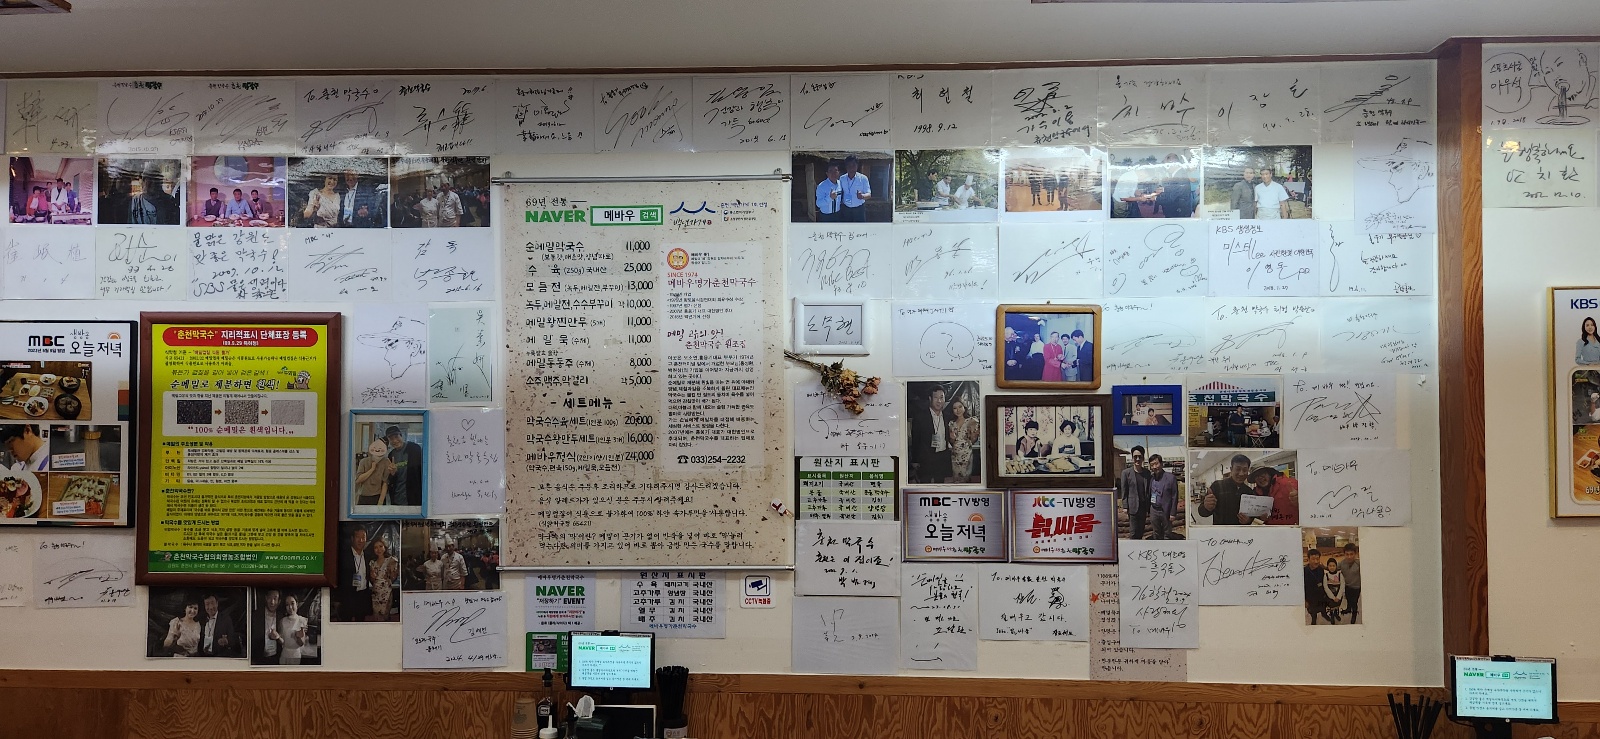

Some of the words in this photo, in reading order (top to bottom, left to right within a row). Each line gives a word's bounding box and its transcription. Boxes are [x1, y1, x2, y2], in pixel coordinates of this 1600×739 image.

[525, 210, 586, 223] NAVER
[604, 209, 635, 222] 메바우
[642, 210, 657, 219] 검색
[1216, 225, 1234, 234] KBS
[526, 241, 585, 253] 순메밀막국수
[626, 240, 650, 251] 11,000
[624, 263, 652, 273] 25,000
[627, 281, 653, 291] 13,000
[1570, 298, 1598, 309] KBS
[526, 317, 587, 328] 메밀왕찐만두
[627, 316, 651, 327] 11,000
[221, 330, 258, 339] 지리적표시
[260, 330, 290, 339] 단체표장
[292, 330, 307, 339] 등록
[628, 335, 651, 345] 11,000
[526, 357, 573, 368] 메밀동동주
[629, 357, 652, 368] 8,000
[170, 379, 209, 390] 순메밀로
[563, 397, 613, 409] 세트메뉴
[624, 415, 653, 426] 20,000
[216, 426, 246, 434] 순메밀은
[627, 432, 653, 444] 16,000
[625, 450, 654, 461] 24,000
[691, 455, 746, 464] 033)254-2232
[684, 482, 742, 491] 감사드리겠습니다.
[535, 586, 586, 596] NAVER
[692, 589, 713, 597] 국내산
[692, 598, 713, 606] 국내산
